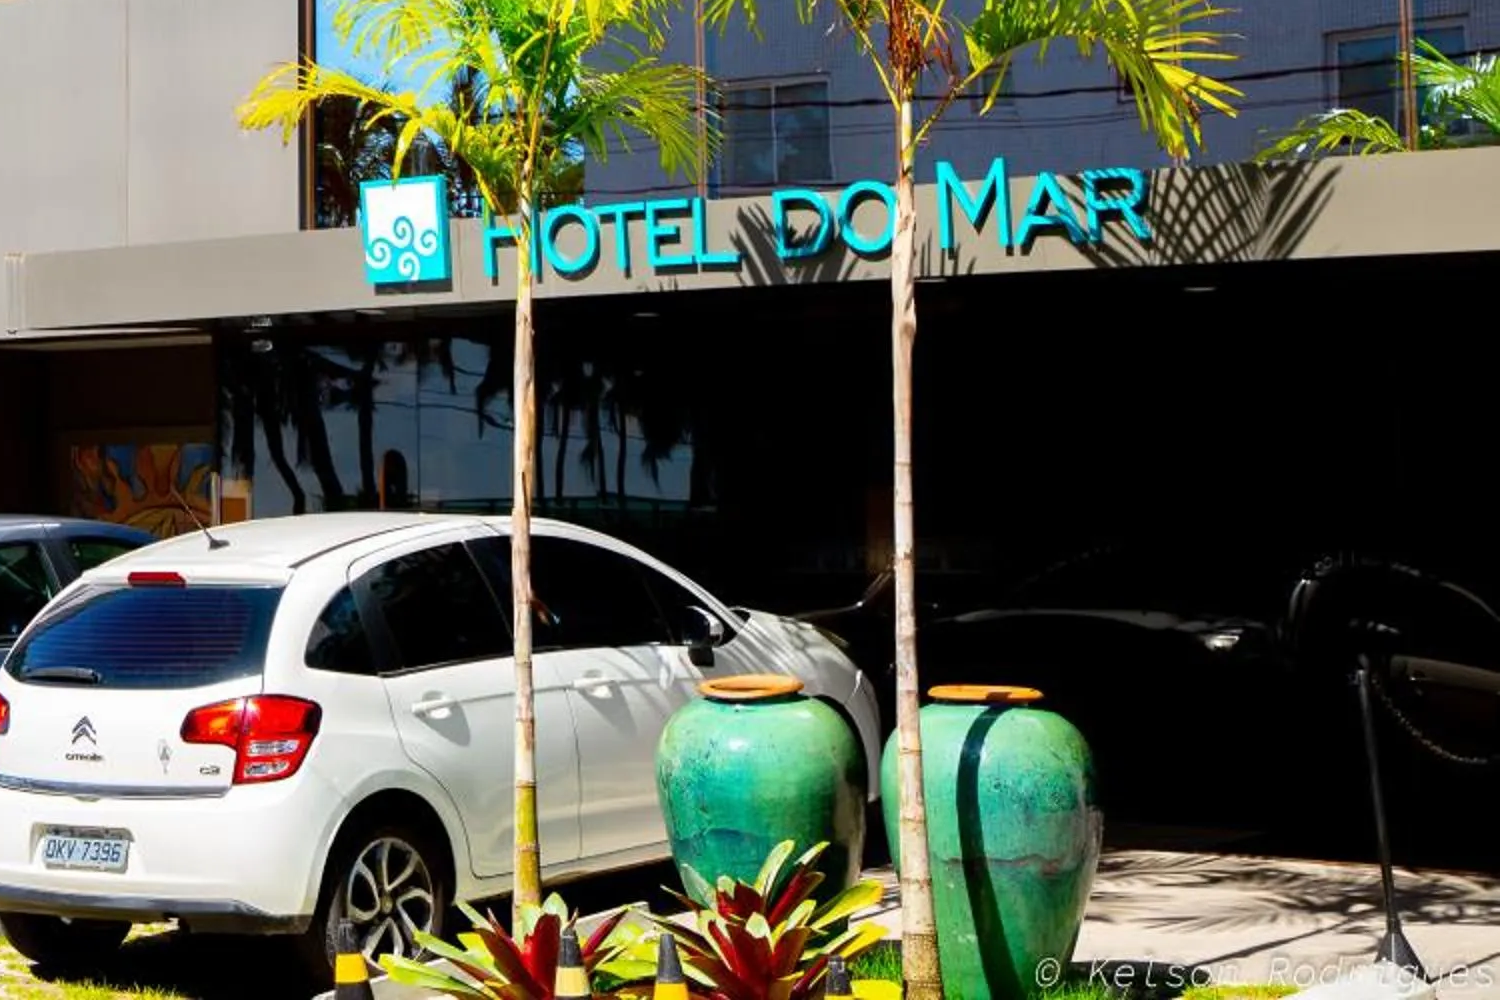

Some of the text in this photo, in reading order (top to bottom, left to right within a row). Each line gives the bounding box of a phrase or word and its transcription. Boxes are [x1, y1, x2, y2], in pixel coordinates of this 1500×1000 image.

[483, 157, 1154, 279] HOTEL DO MAR
